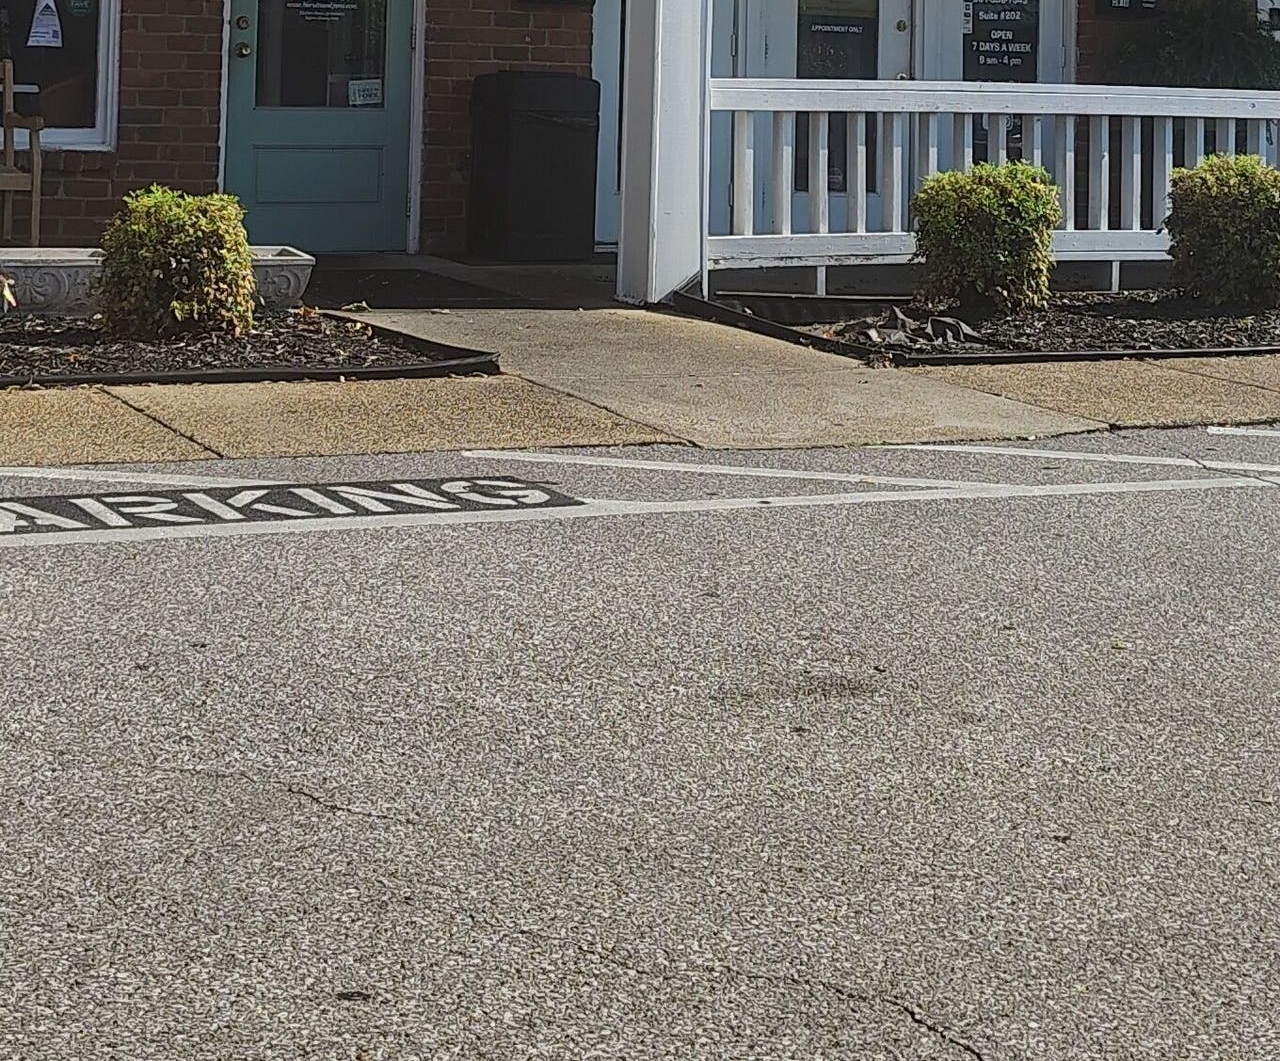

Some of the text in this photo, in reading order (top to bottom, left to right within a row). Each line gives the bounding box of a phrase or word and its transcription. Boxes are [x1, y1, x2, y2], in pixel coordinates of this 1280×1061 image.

[978, 11, 999, 20] Suite
[990, 30, 1013, 40] OPEN
[979, 42, 1000, 52] DAYS
